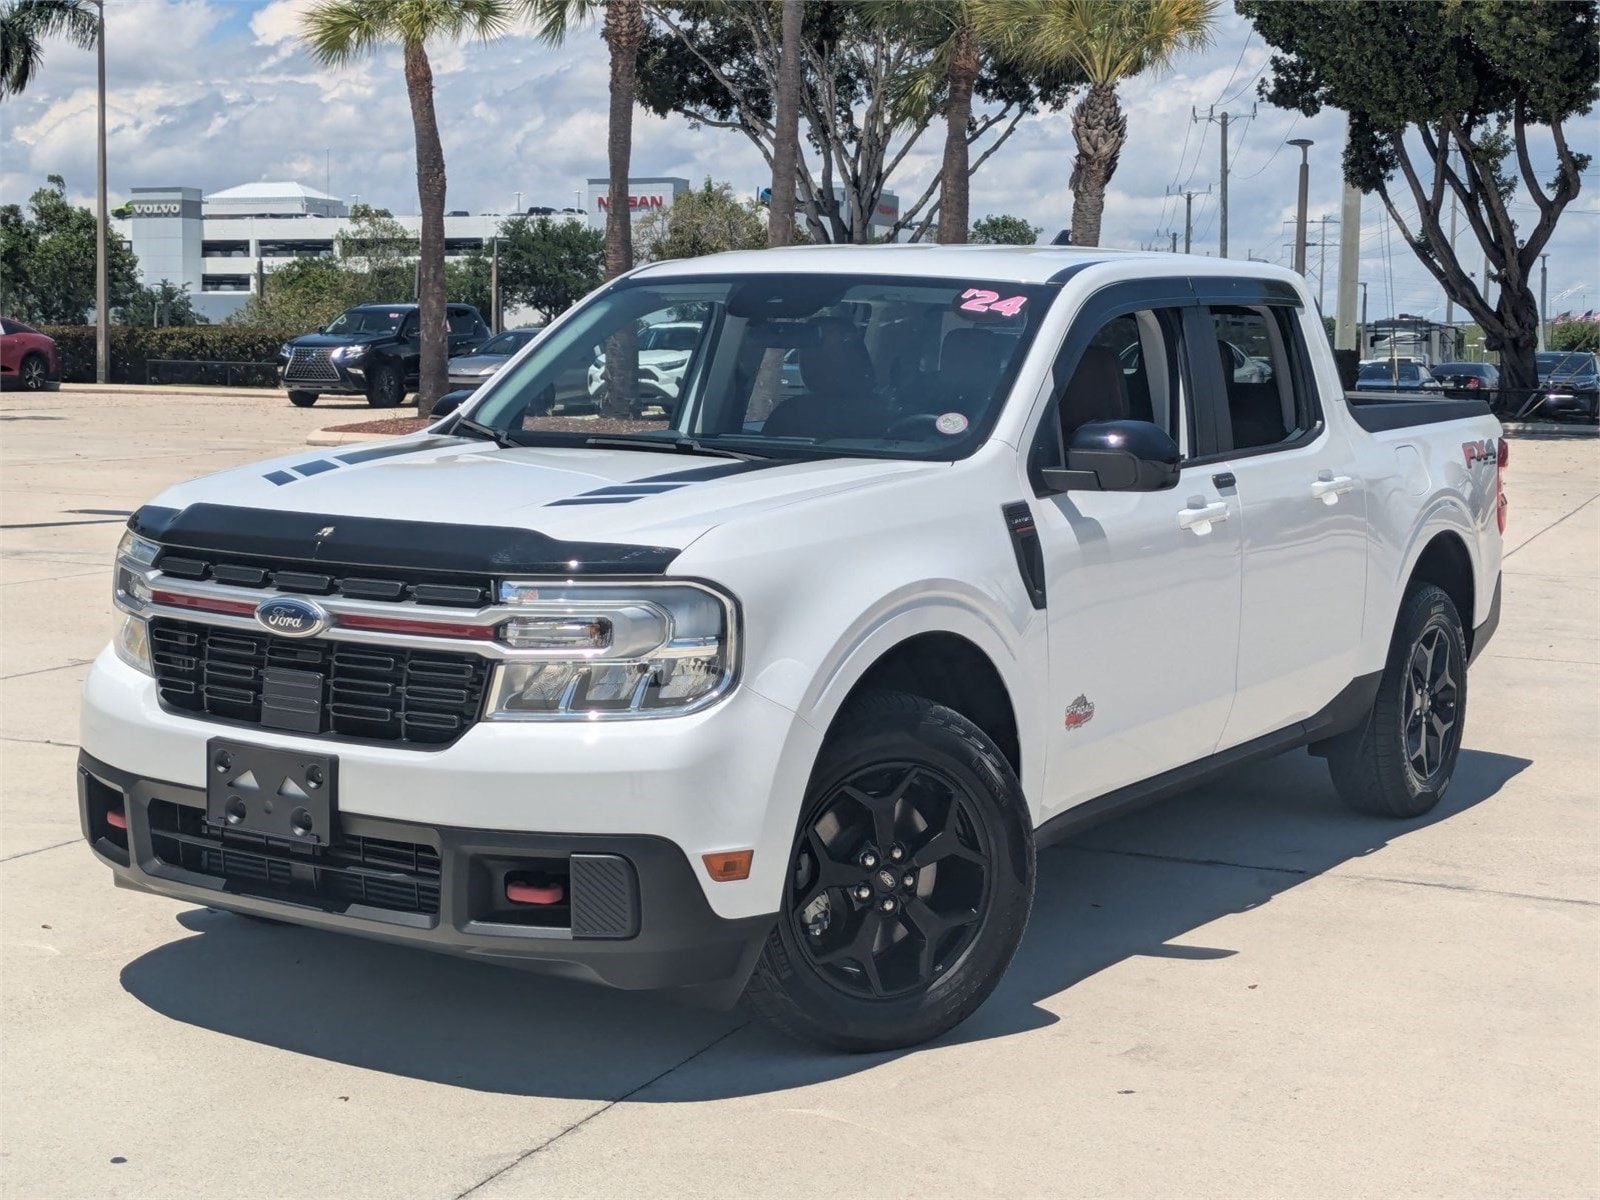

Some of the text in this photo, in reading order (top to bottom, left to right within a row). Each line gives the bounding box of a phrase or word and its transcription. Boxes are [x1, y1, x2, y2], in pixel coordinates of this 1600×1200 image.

[133, 203, 180, 214] VOLVO
[597, 195, 663, 210] NSAN
[1461, 438, 1497, 470] FX4
[268, 606, 305, 628] Ford
